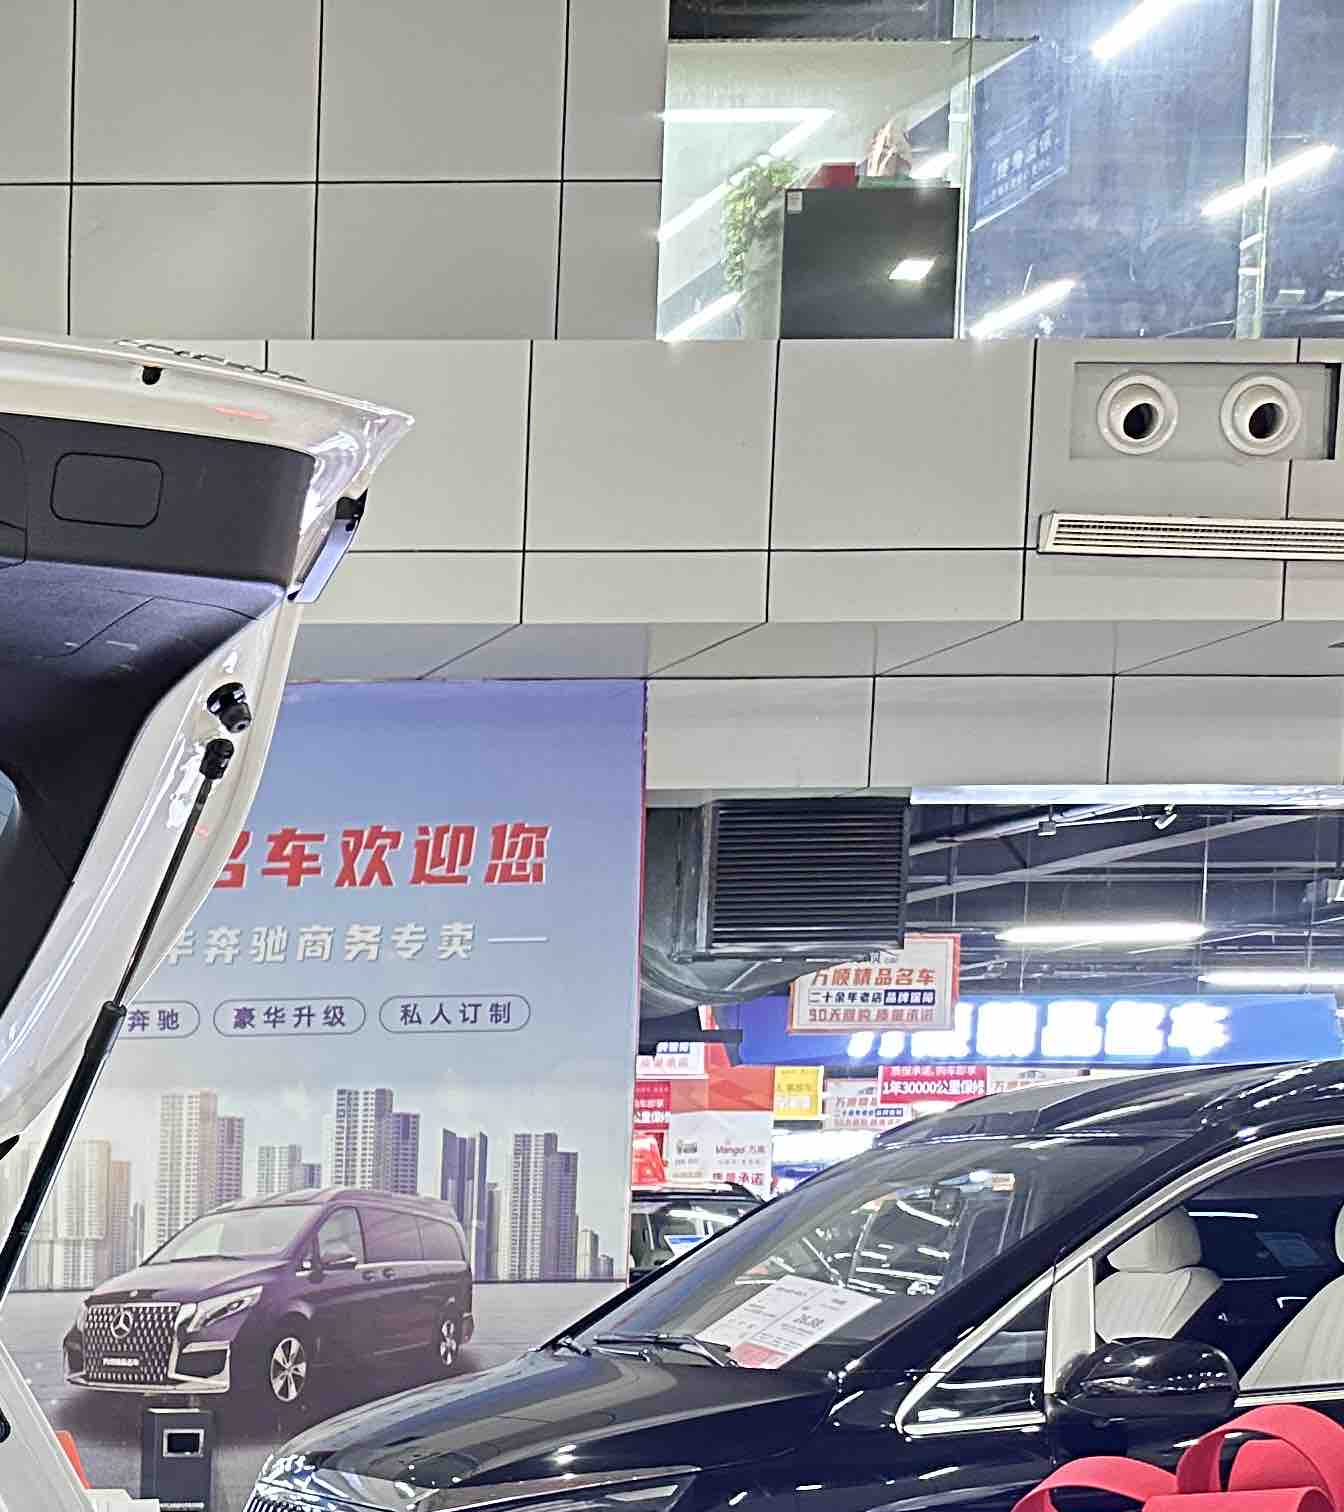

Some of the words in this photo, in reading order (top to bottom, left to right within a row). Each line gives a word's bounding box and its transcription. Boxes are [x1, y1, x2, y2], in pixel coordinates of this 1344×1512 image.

[811, 966, 937, 987] 万顺精品名车
[231, 1005, 348, 1031] 豪华升级
[398, 1001, 513, 1027] 私人订制
